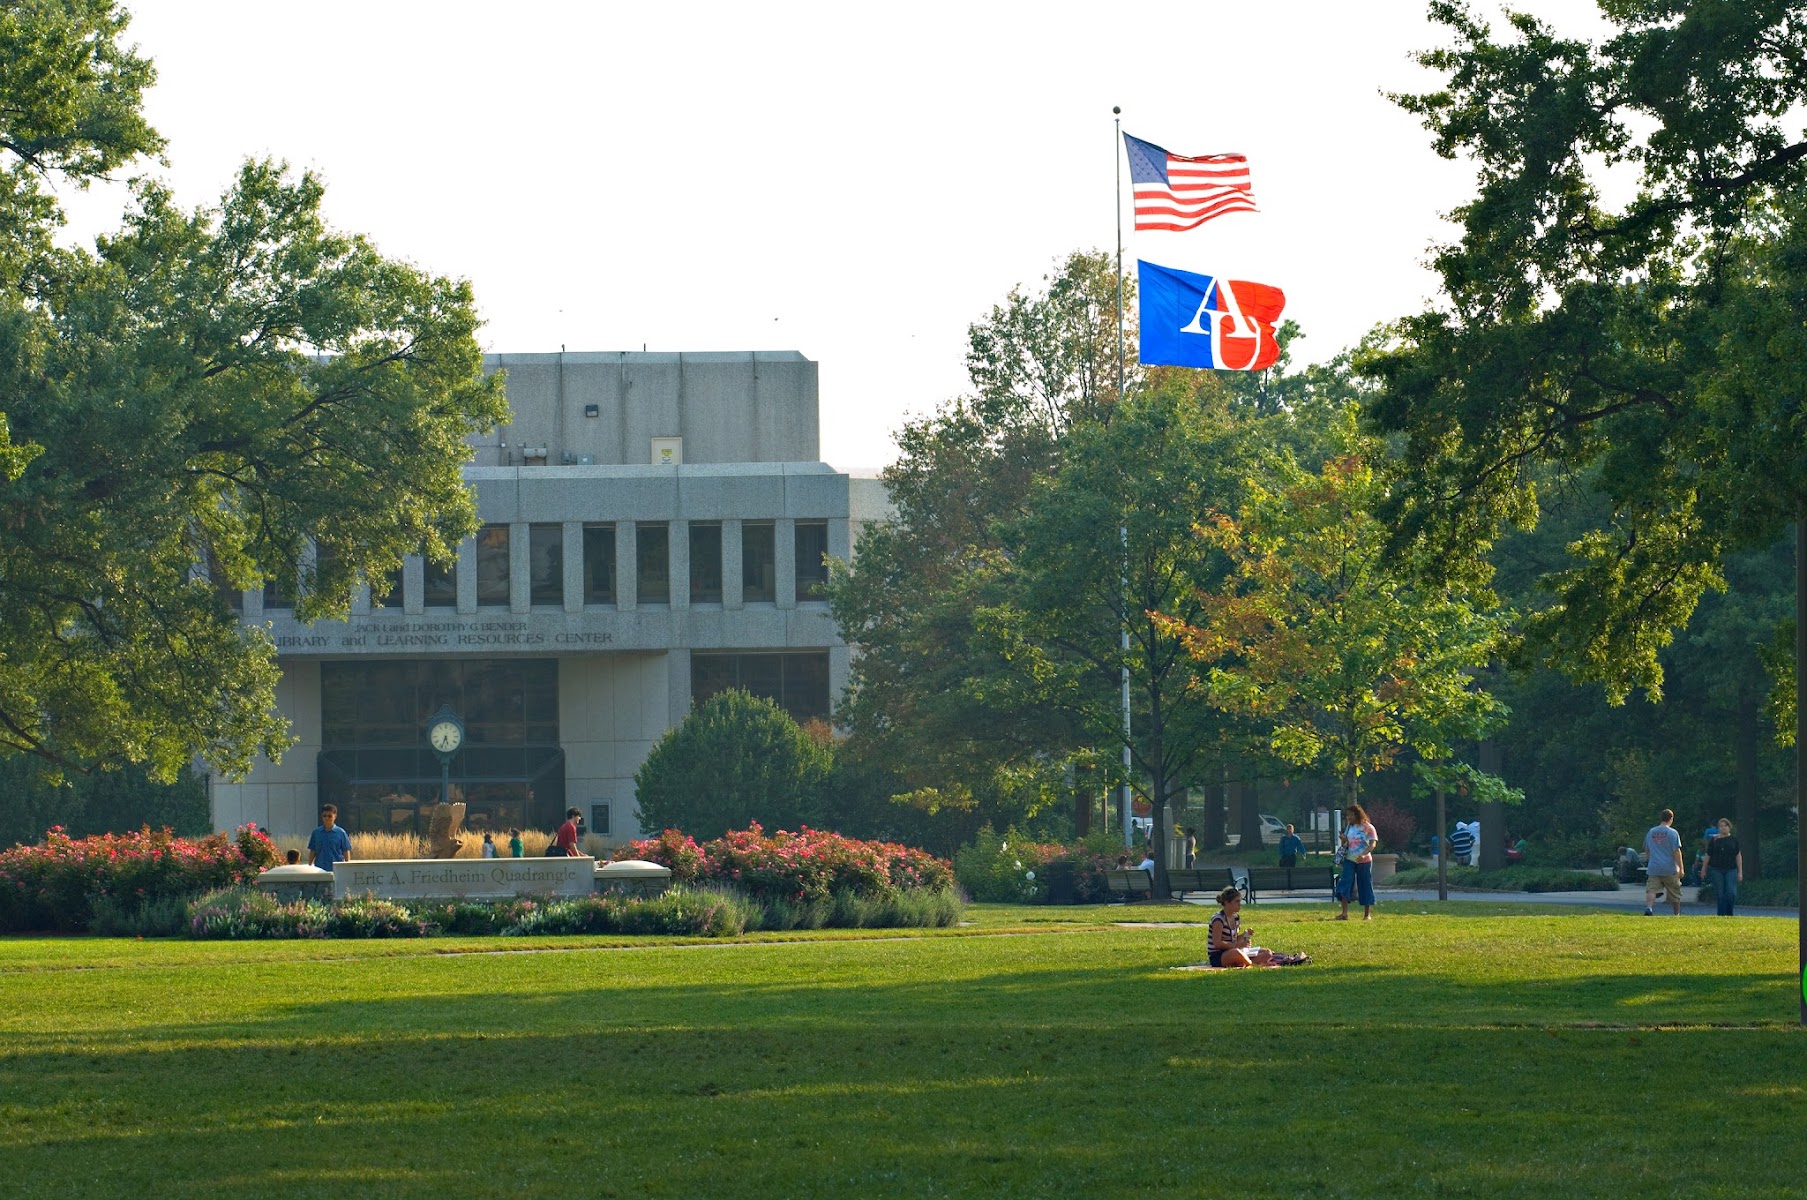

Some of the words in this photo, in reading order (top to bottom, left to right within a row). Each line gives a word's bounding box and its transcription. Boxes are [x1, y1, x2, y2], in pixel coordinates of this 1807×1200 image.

[354, 623, 381, 633] JACK
[389, 622, 410, 632] and
[412, 622, 467, 632] DOROTHY
[481, 622, 528, 631] BENDER
[341, 634, 366, 646] and
[377, 634, 449, 646] LEARNING
[457, 633, 545, 645] RESOURCES
[555, 632, 614, 643] CENTER
[353, 871, 384, 885] Eric
[389, 870, 405, 885] A.
[408, 869, 486, 884] Friedheim
[490, 867, 577, 886] Quadrangle
